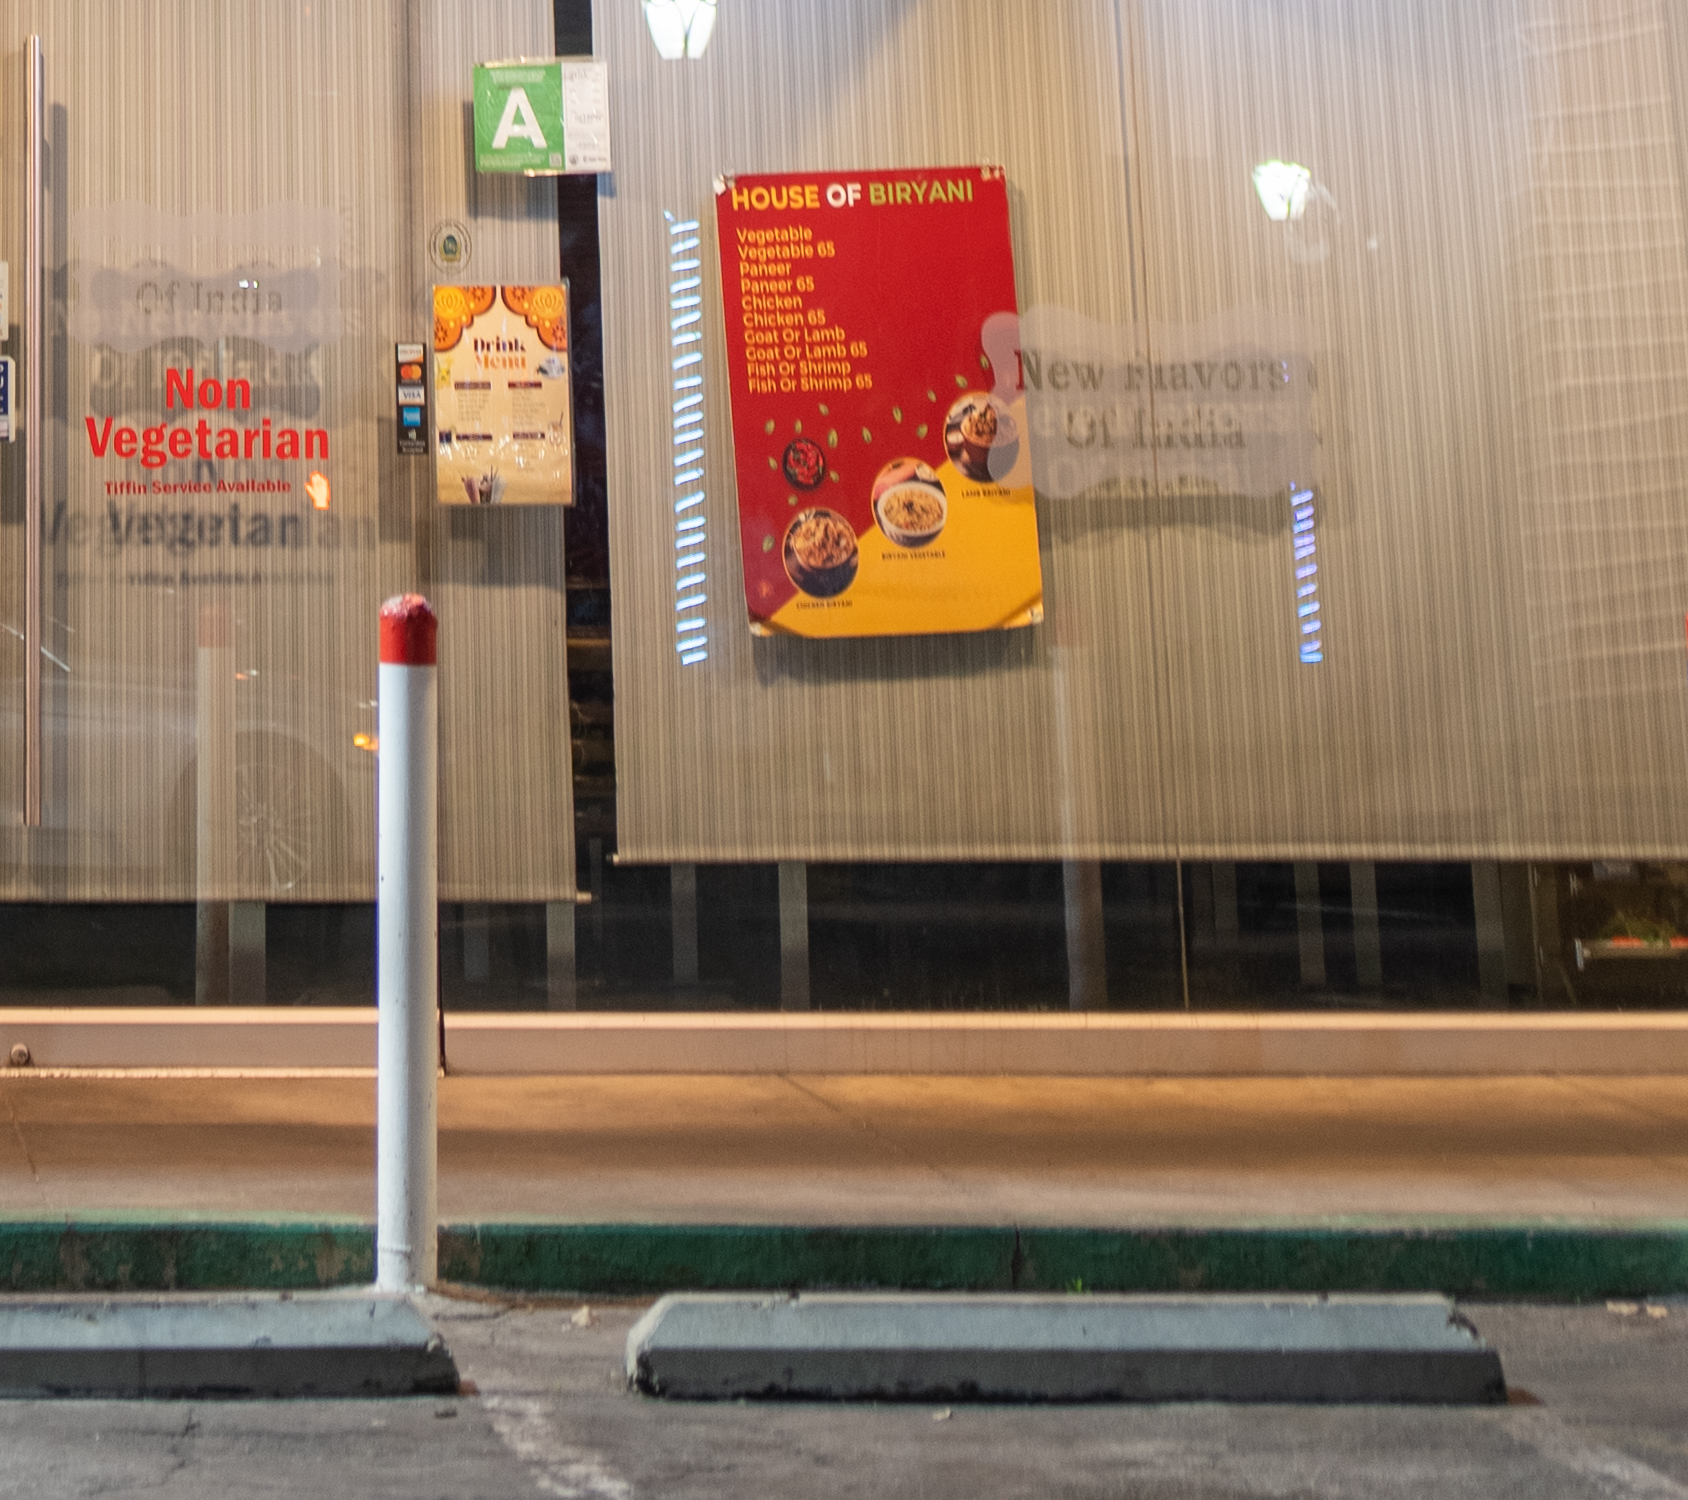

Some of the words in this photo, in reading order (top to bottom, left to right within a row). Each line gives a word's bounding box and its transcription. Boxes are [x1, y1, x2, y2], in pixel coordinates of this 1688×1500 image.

[492, 87, 548, 149] A
[732, 185, 821, 211] HOUSE
[826, 182, 861, 208] OF
[869, 179, 973, 206] BIRYANI
[737, 224, 813, 245] Vegetable
[738, 243, 814, 262] Vegetable
[817, 241, 835, 258] 65
[740, 262, 791, 276] Paneer
[741, 278, 793, 294] Paneer
[796, 276, 814, 293] 65
[741, 294, 802, 311] Chicken
[743, 311, 803, 328] Chicken
[807, 309, 826, 325] 65
[474, 336, 526, 352] Drink
[745, 329, 779, 344] Goat
[782, 328, 802, 342] Or
[804, 325, 845, 342] Lamb
[746, 345, 780, 361] Goat
[784, 344, 802, 360] Or
[806, 342, 847, 359] Lamb
[850, 341, 868, 358] 65
[474, 353, 527, 370] Menu
[747, 362, 775, 377] Fish
[779, 361, 796, 376] Or
[800, 360, 851, 376] Shrimp
[1014, 349, 1104, 391] New
[166, 367, 251, 410] Non
[748, 377, 777, 393] Fish
[780, 377, 797, 392] Or
[800, 376, 852, 393] Shrimp
[856, 374, 873, 390] 65
[403, 391, 421, 399] VISA
[85, 417, 329, 469] Vegetarian
[104, 481, 147, 495] Tiffin
[152, 480, 212, 495] Service
[216, 479, 291, 493] Available
